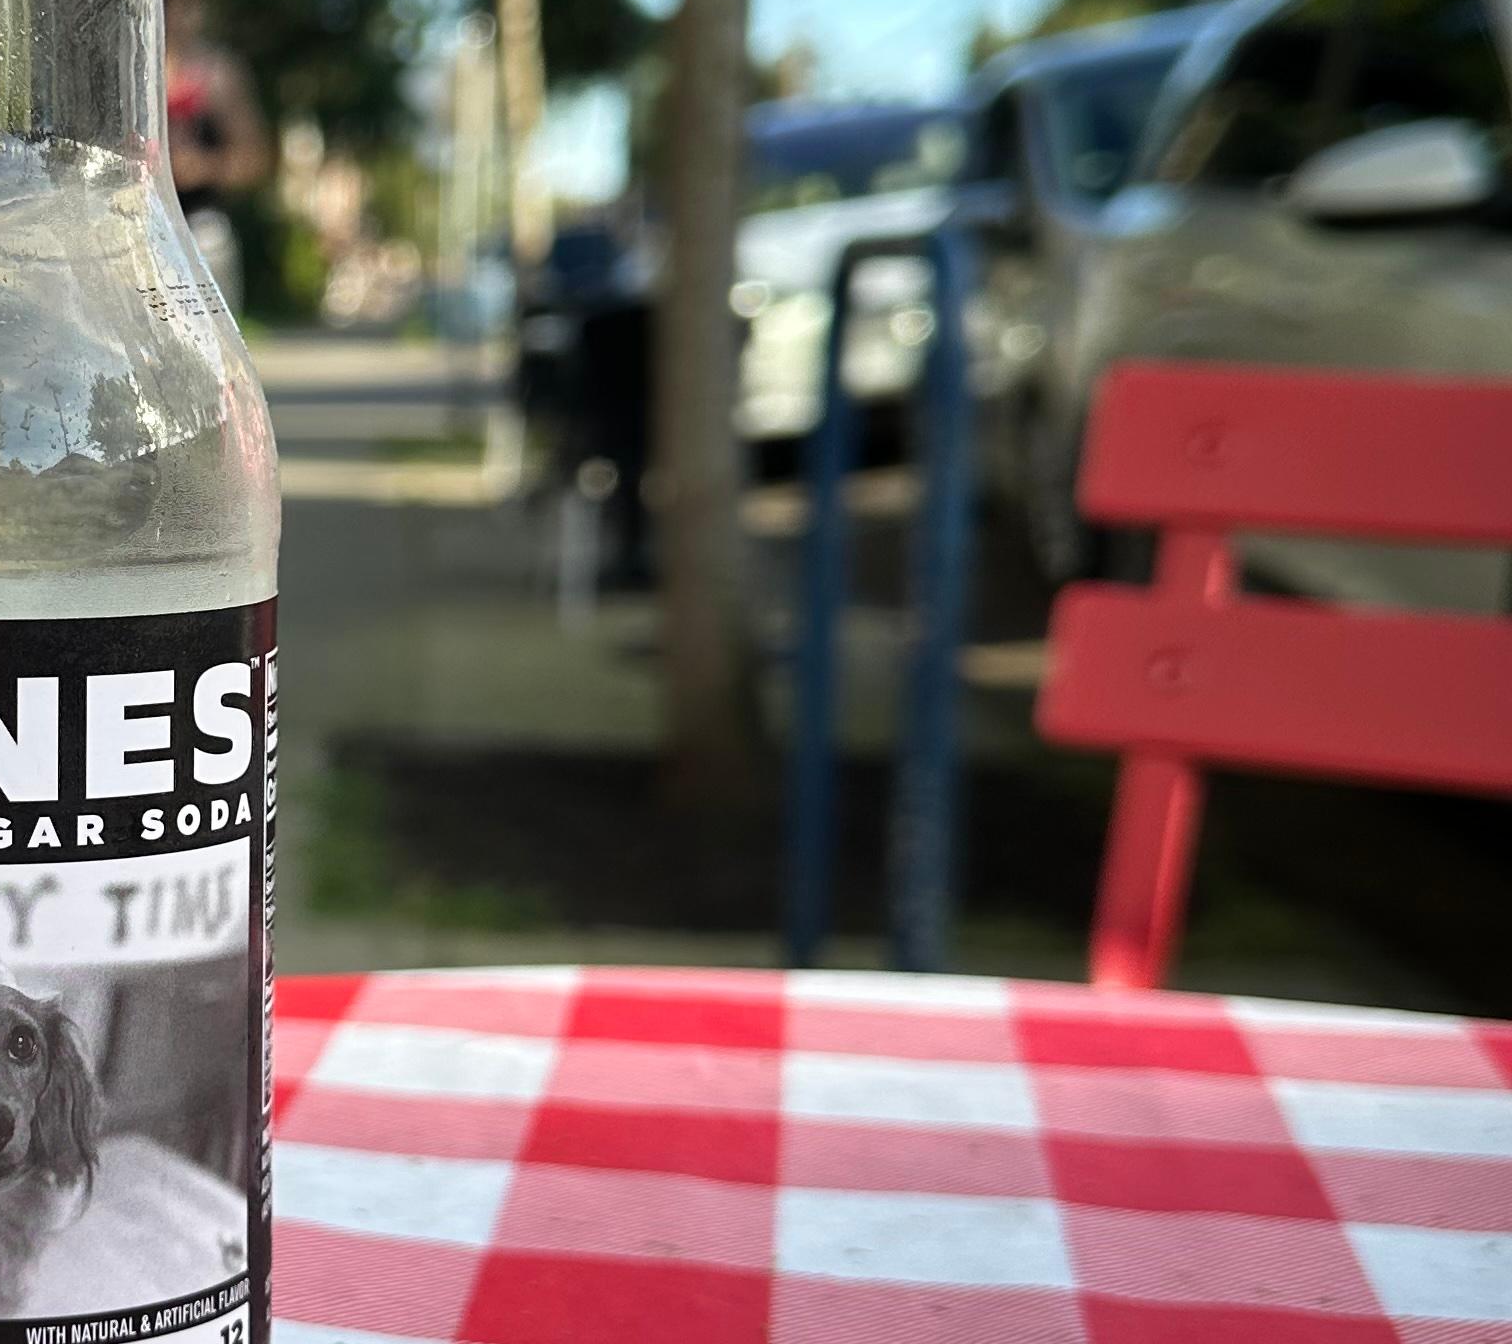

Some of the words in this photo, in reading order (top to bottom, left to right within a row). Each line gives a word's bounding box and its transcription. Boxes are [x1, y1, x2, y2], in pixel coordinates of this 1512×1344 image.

[141, 792, 252, 839] SODA
[71, 1317, 137, 1344] NATURAL
[140, 1315, 152, 1333] &
[155, 1297, 217, 1331] ARTIFICIAL
[219, 1277, 250, 1310] FLAVOR
